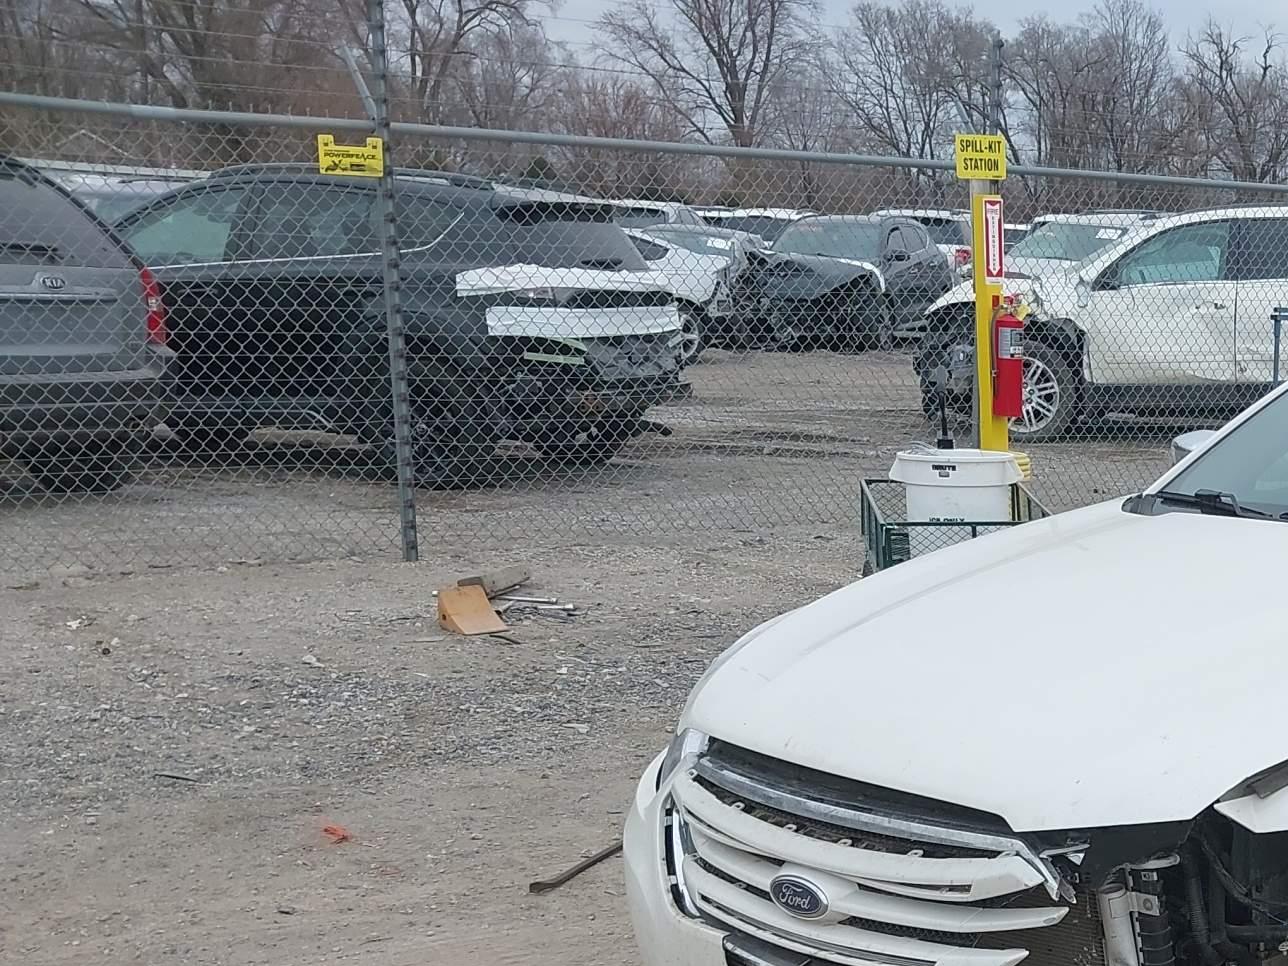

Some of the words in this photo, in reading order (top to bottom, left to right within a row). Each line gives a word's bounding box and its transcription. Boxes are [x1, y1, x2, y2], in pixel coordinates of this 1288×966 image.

[959, 138, 1001, 153] SPILL-KIT
[963, 157, 999, 171] STATION
[43, 277, 66, 289] KIA
[780, 884, 811, 909] Ford
